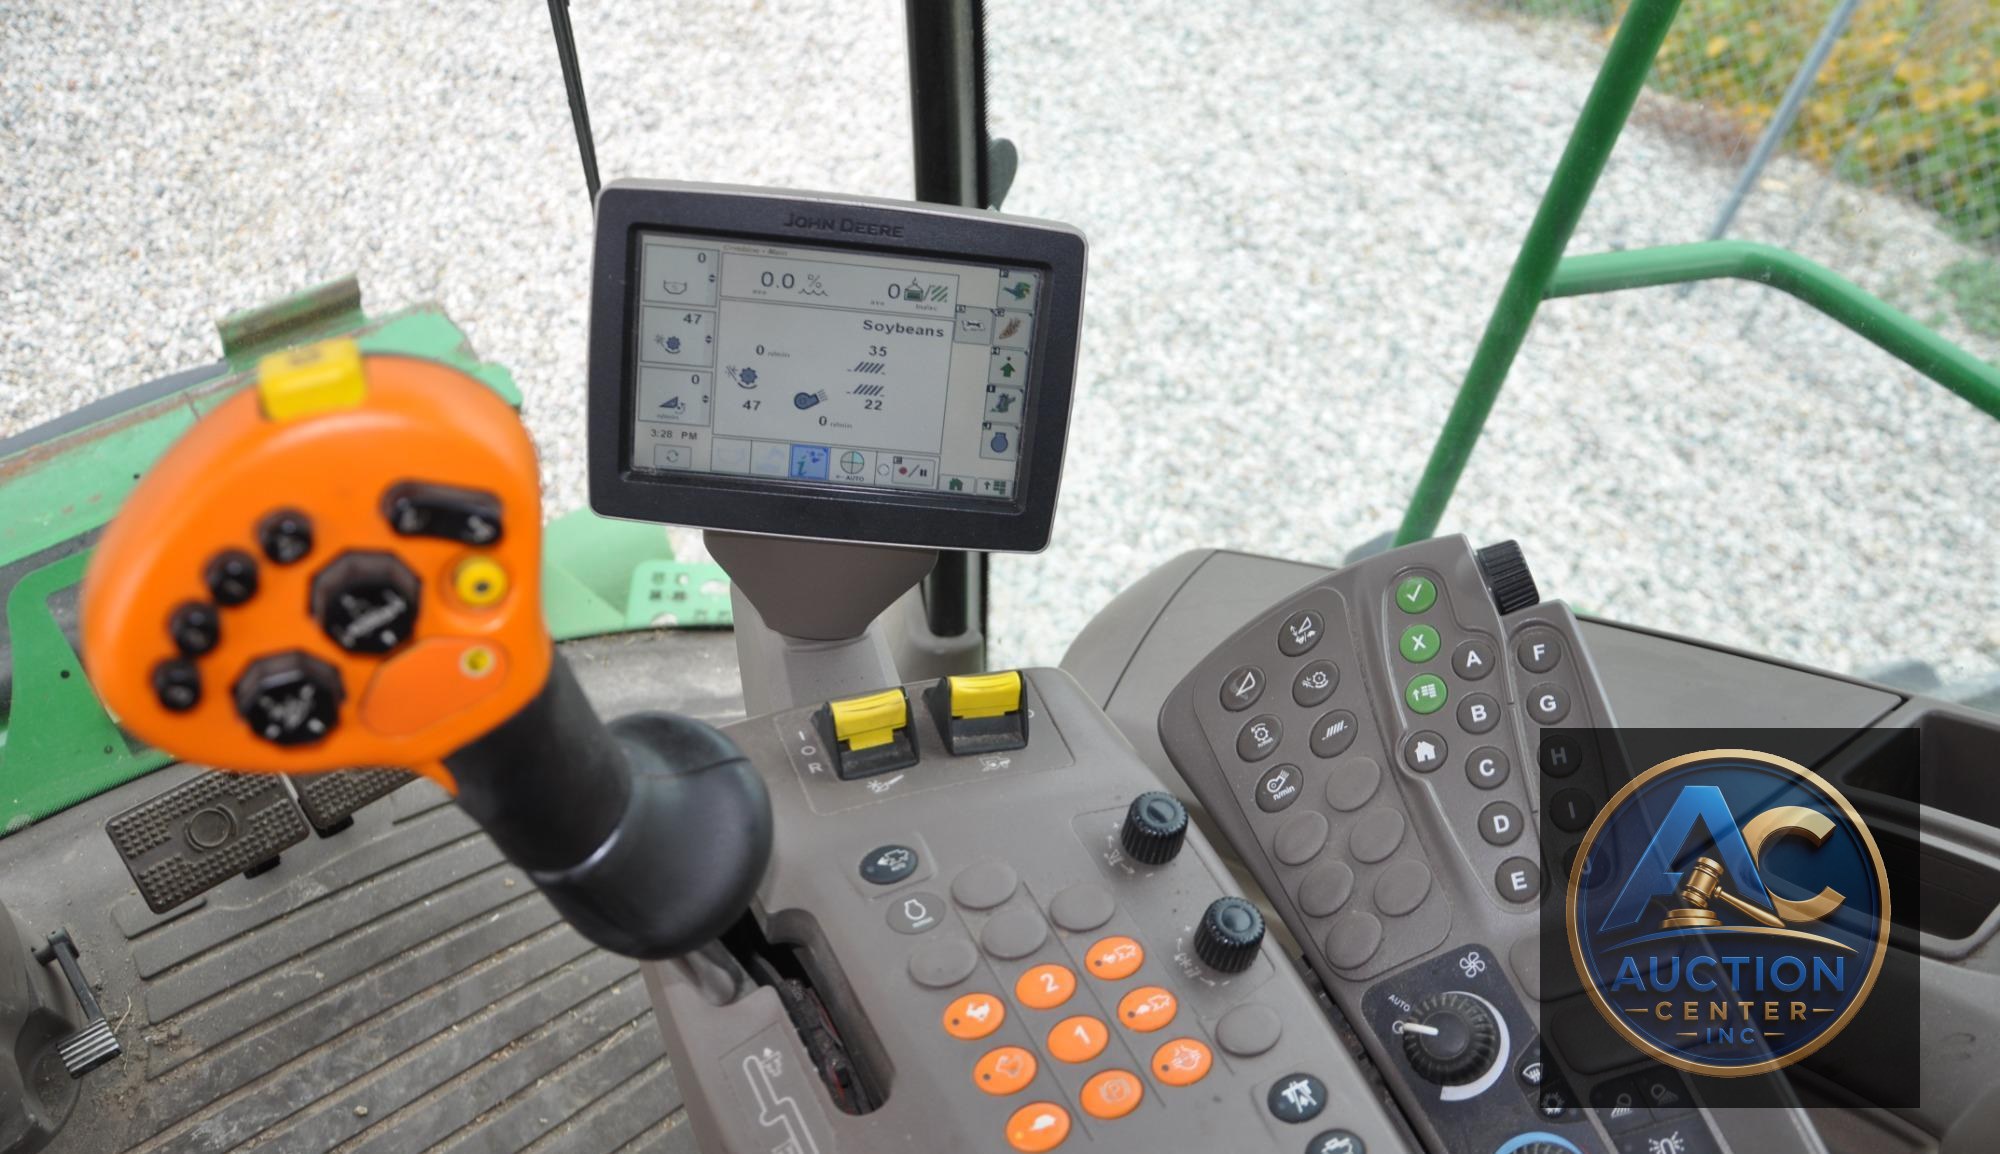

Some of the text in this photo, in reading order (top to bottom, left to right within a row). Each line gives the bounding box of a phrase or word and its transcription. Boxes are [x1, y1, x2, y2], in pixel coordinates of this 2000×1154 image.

[783, 212, 904, 238] JOHN DEERE
[697, 252, 707, 264] 0
[761, 271, 795, 289] 0.0
[886, 283, 901, 299] 0
[683, 313, 702, 325] 47
[863, 319, 945, 338] Soybeans
[756, 344, 765, 356] 0
[868, 345, 888, 358] 35
[691, 374, 700, 385] 0
[742, 400, 761, 411] 47
[864, 399, 883, 411] 22
[818, 416, 828, 426] 0
[650, 429, 698, 440] 3:28 PM
[1465, 651, 1481, 667] A
[1533, 645, 1545, 661] F
[1539, 695, 1556, 712] G
[1471, 705, 1487, 722] B
[1550, 747, 1567, 766] H
[807, 762, 823, 774] R
[1479, 760, 1495, 777] C
[1493, 815, 1509, 833] D
[1511, 872, 1527, 891] E
[1039, 972, 1060, 993] 2
[1388, 994, 1410, 1012] AUTO
[1073, 1024, 1091, 1045] 1
